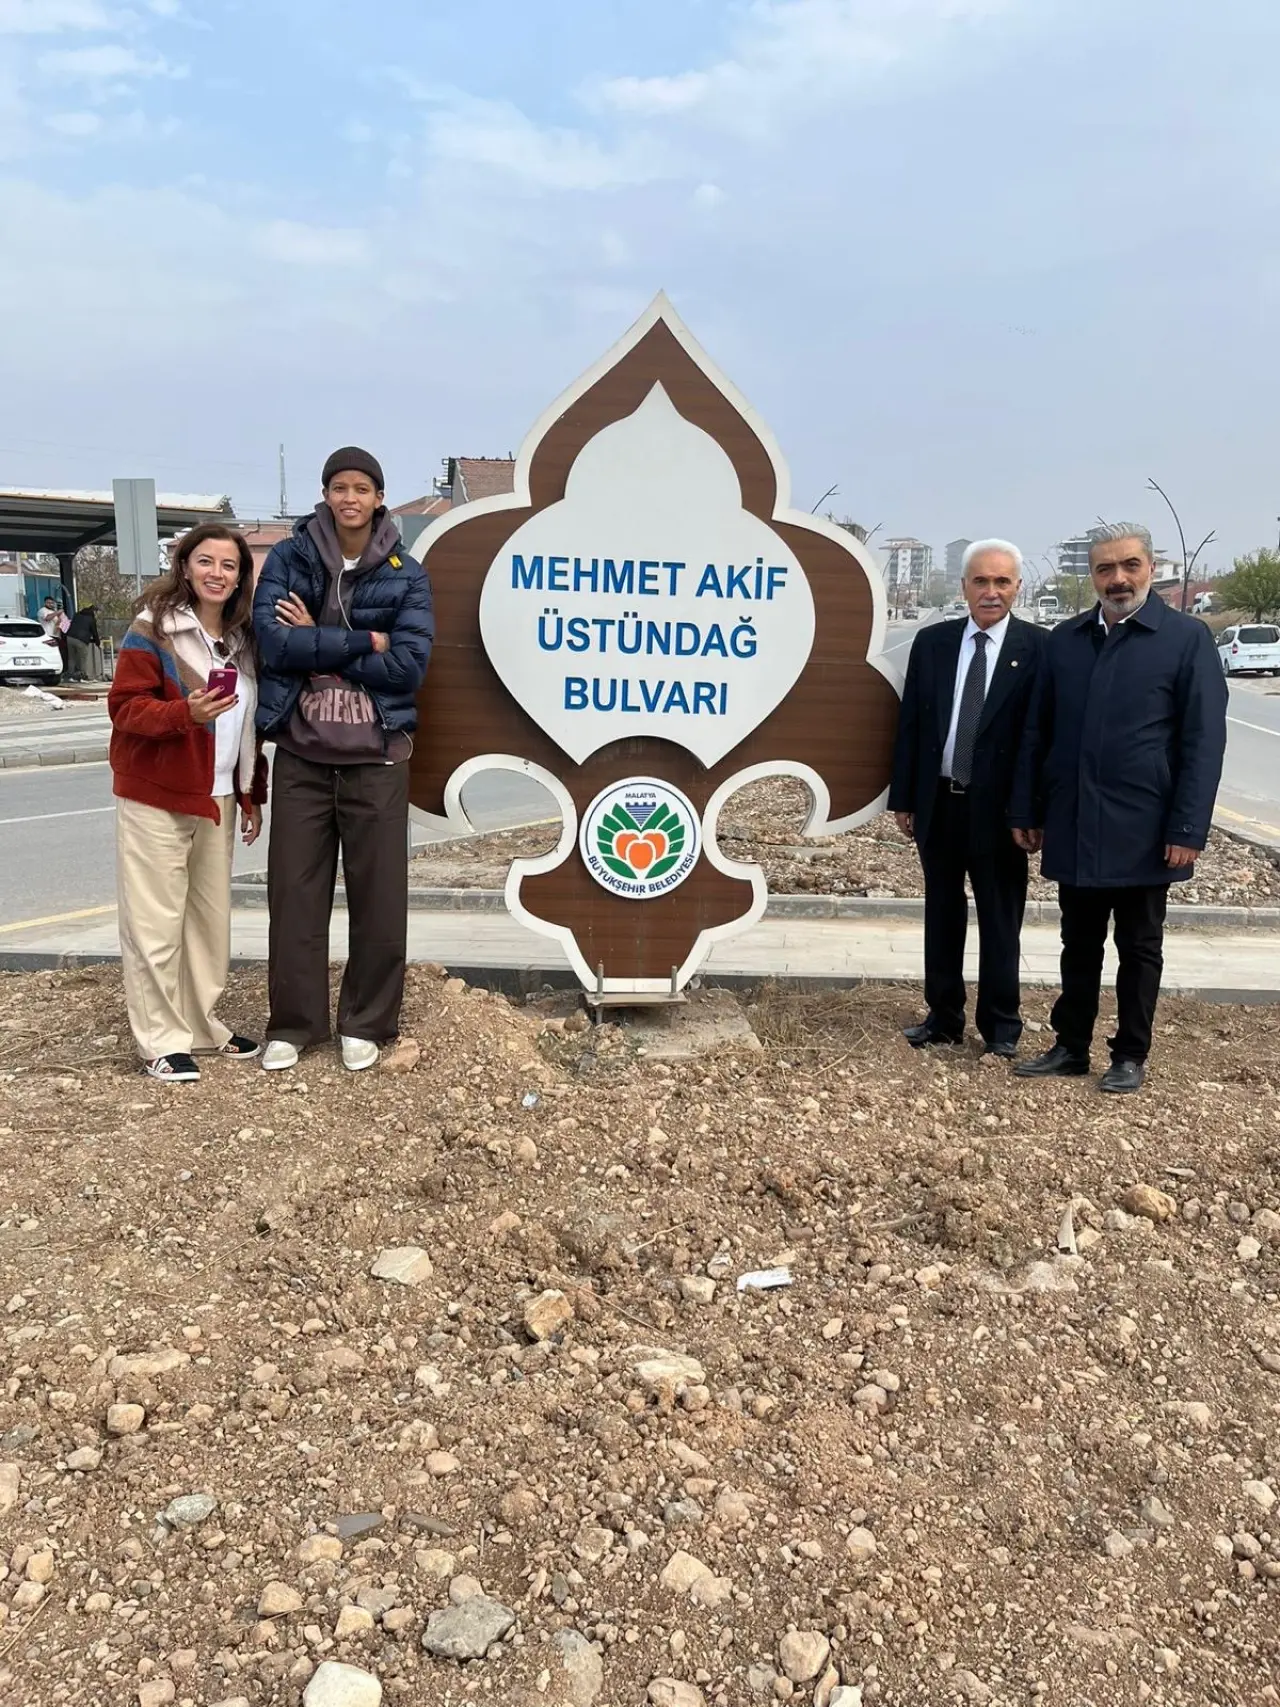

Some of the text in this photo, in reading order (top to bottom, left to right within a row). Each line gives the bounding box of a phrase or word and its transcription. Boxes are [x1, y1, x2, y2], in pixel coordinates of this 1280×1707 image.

[511, 554, 788, 600] MEHMET AKİF
[538, 607, 758, 659] ÜSTÜNDAĞ
[564, 676, 728, 715] BULVARI
[588, 855, 646, 894] BÜYÜKŞEHİR
[649, 853, 695, 893] BELEDİYESİ
